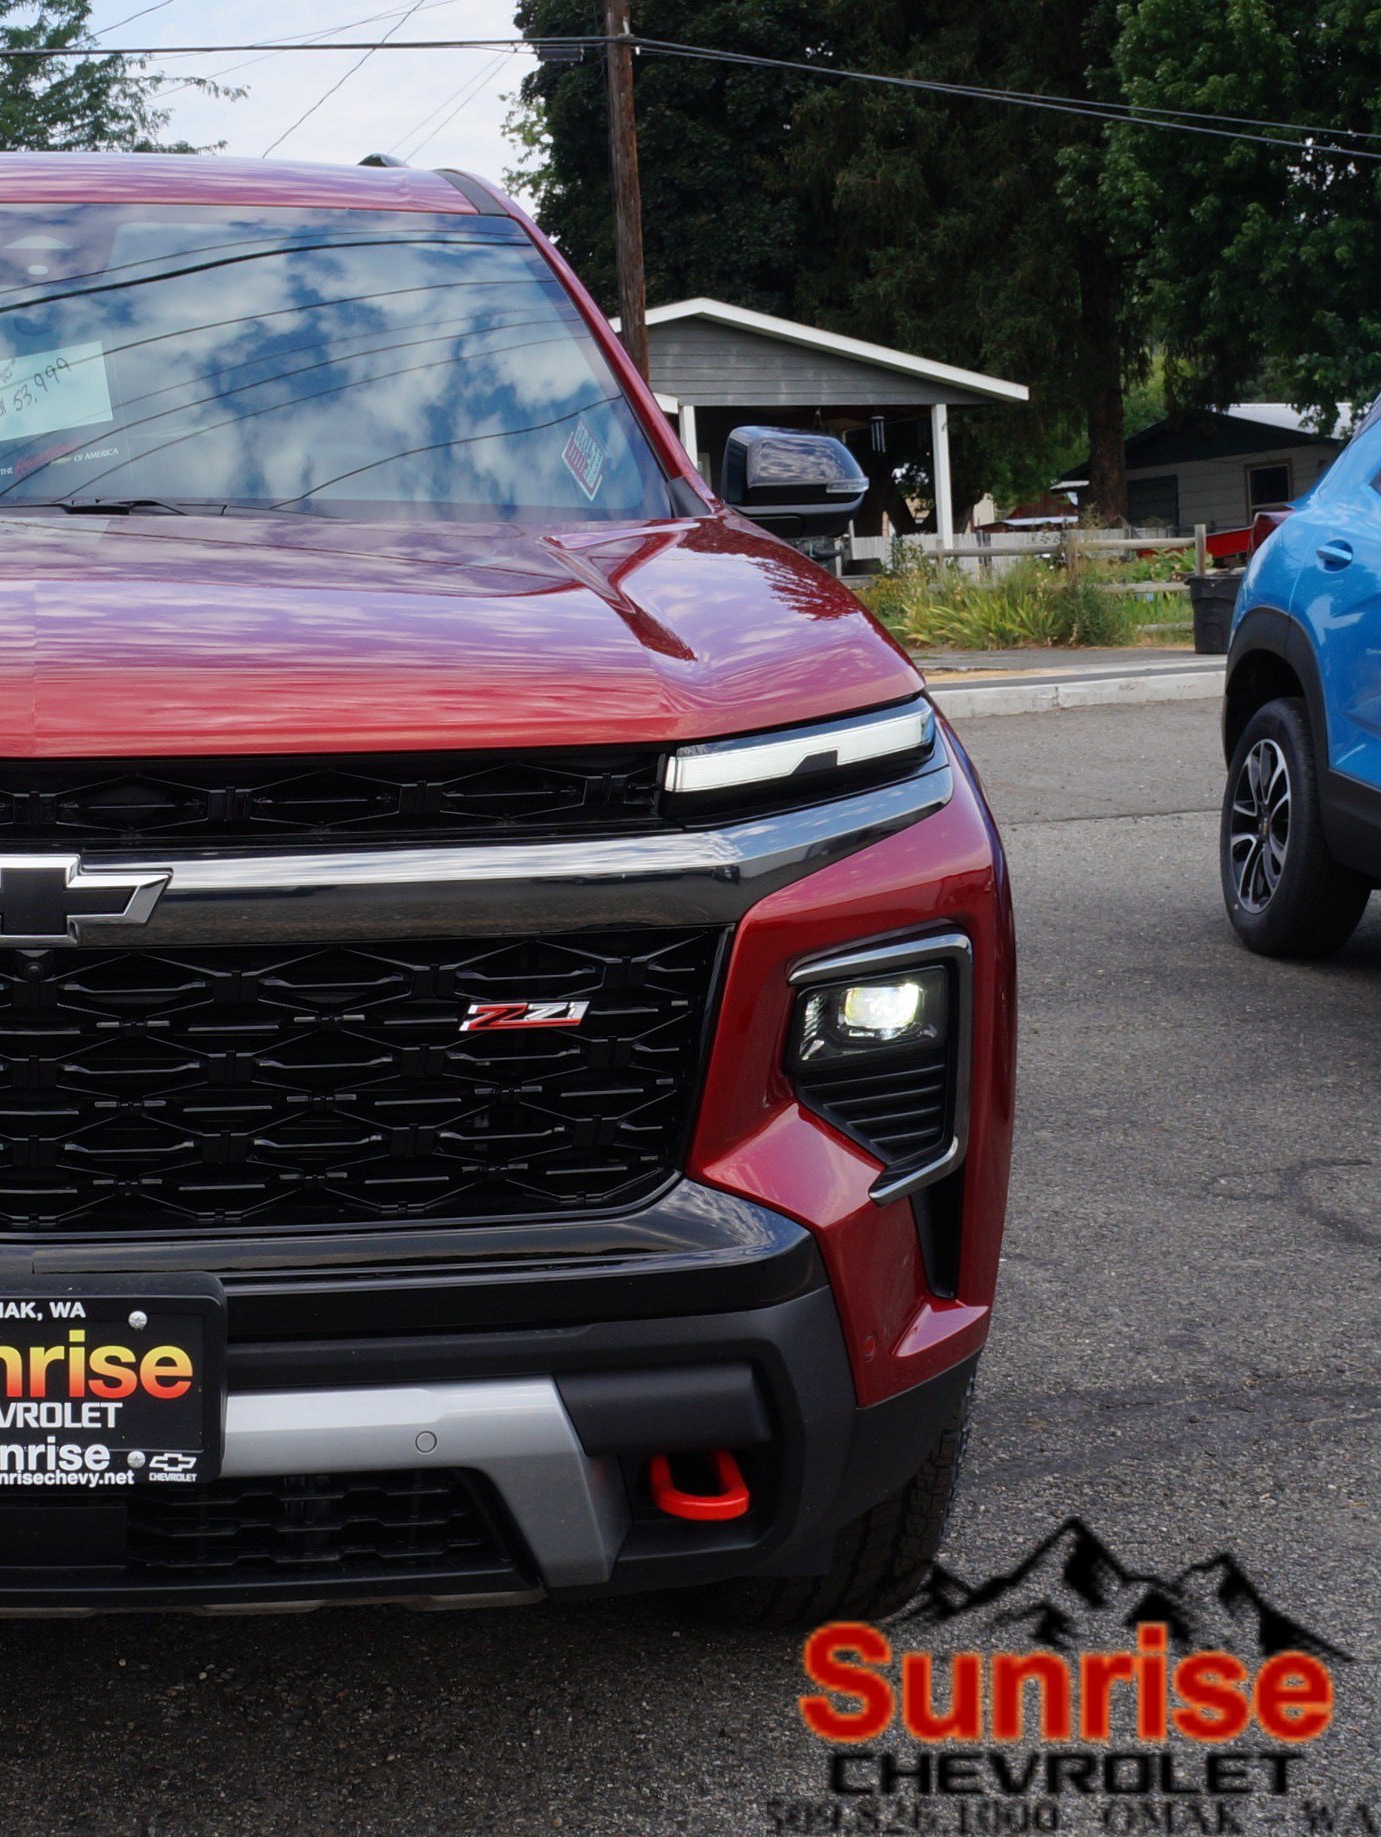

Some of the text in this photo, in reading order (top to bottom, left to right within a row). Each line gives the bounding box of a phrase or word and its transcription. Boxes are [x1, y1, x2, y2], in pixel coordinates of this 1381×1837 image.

[0, 466, 14, 476] THE
[50, 1302, 86, 1318] WA
[149, 1472, 197, 1482] CHEVROLET
